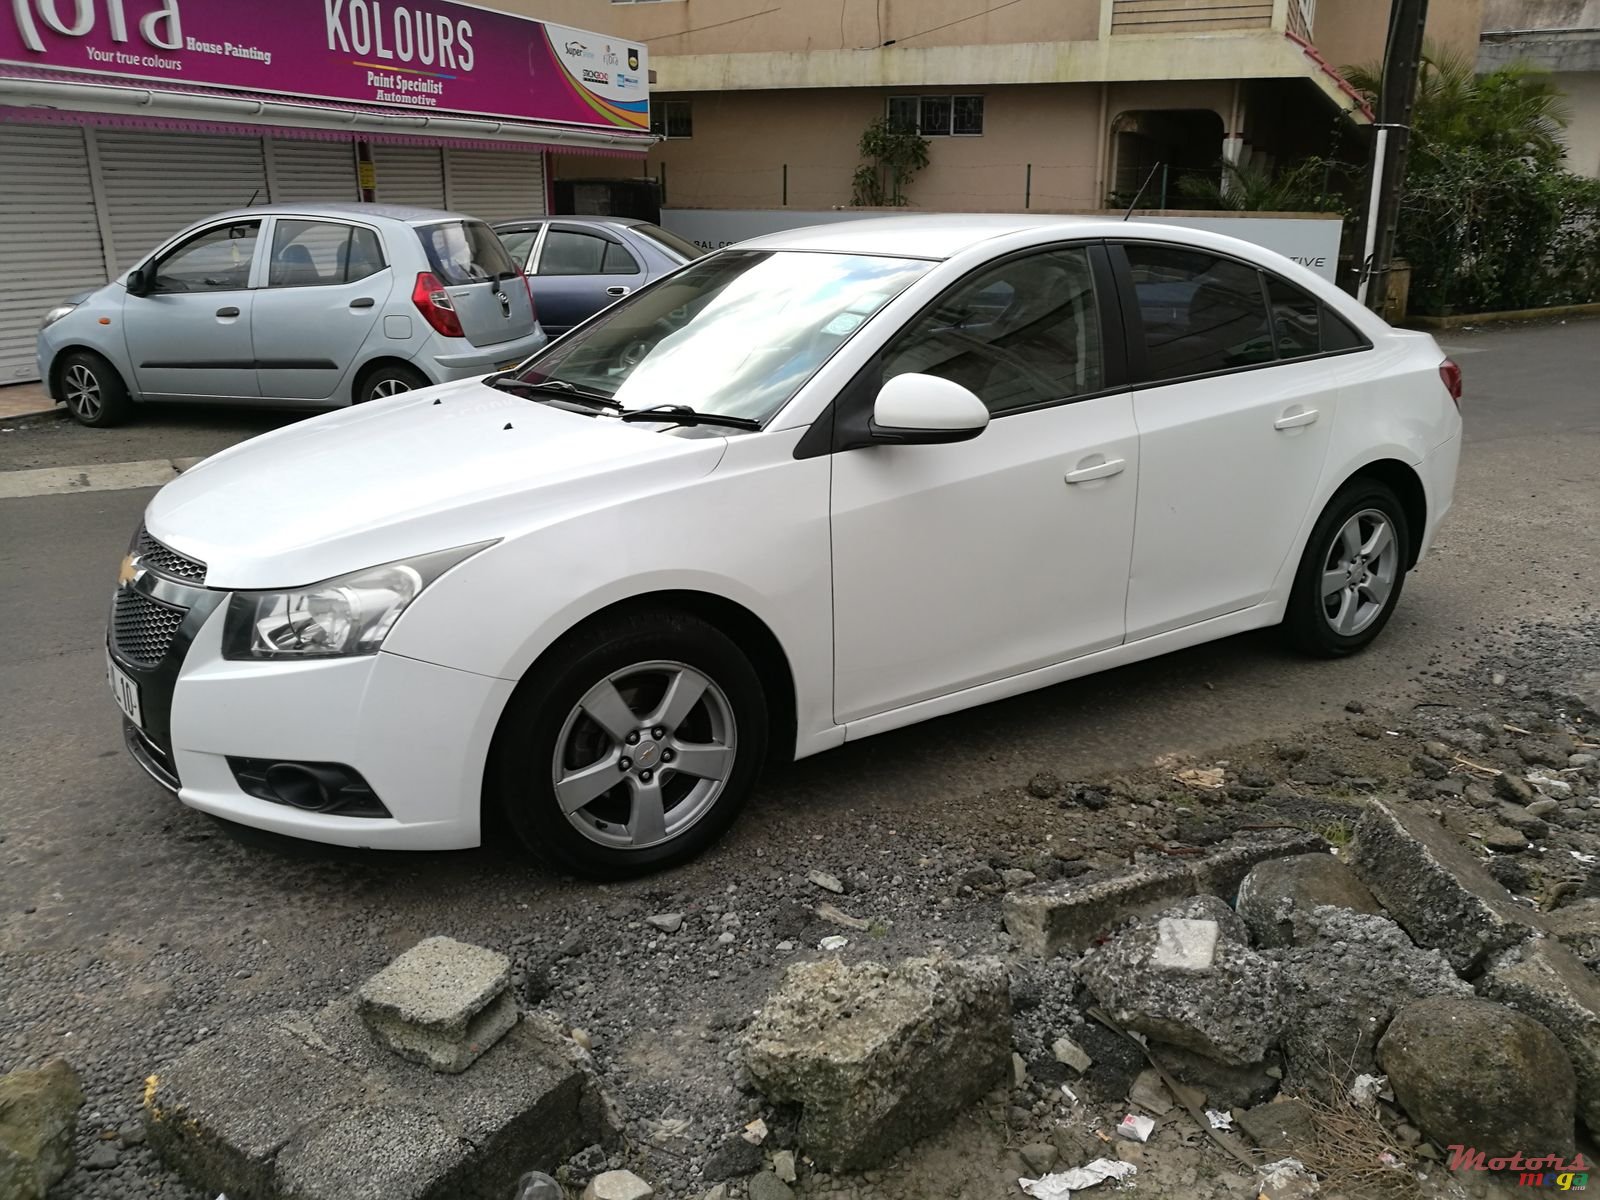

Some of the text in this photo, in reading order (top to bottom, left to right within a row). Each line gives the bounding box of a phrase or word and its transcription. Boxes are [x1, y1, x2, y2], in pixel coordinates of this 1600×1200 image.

[324, 0, 475, 72] KOLOURS
[86, 46, 182, 71] Your true colours
[186, 36, 272, 65] House Painting
[367, 70, 443, 95] Paint Specialist
[376, 89, 437, 106] Automotive
